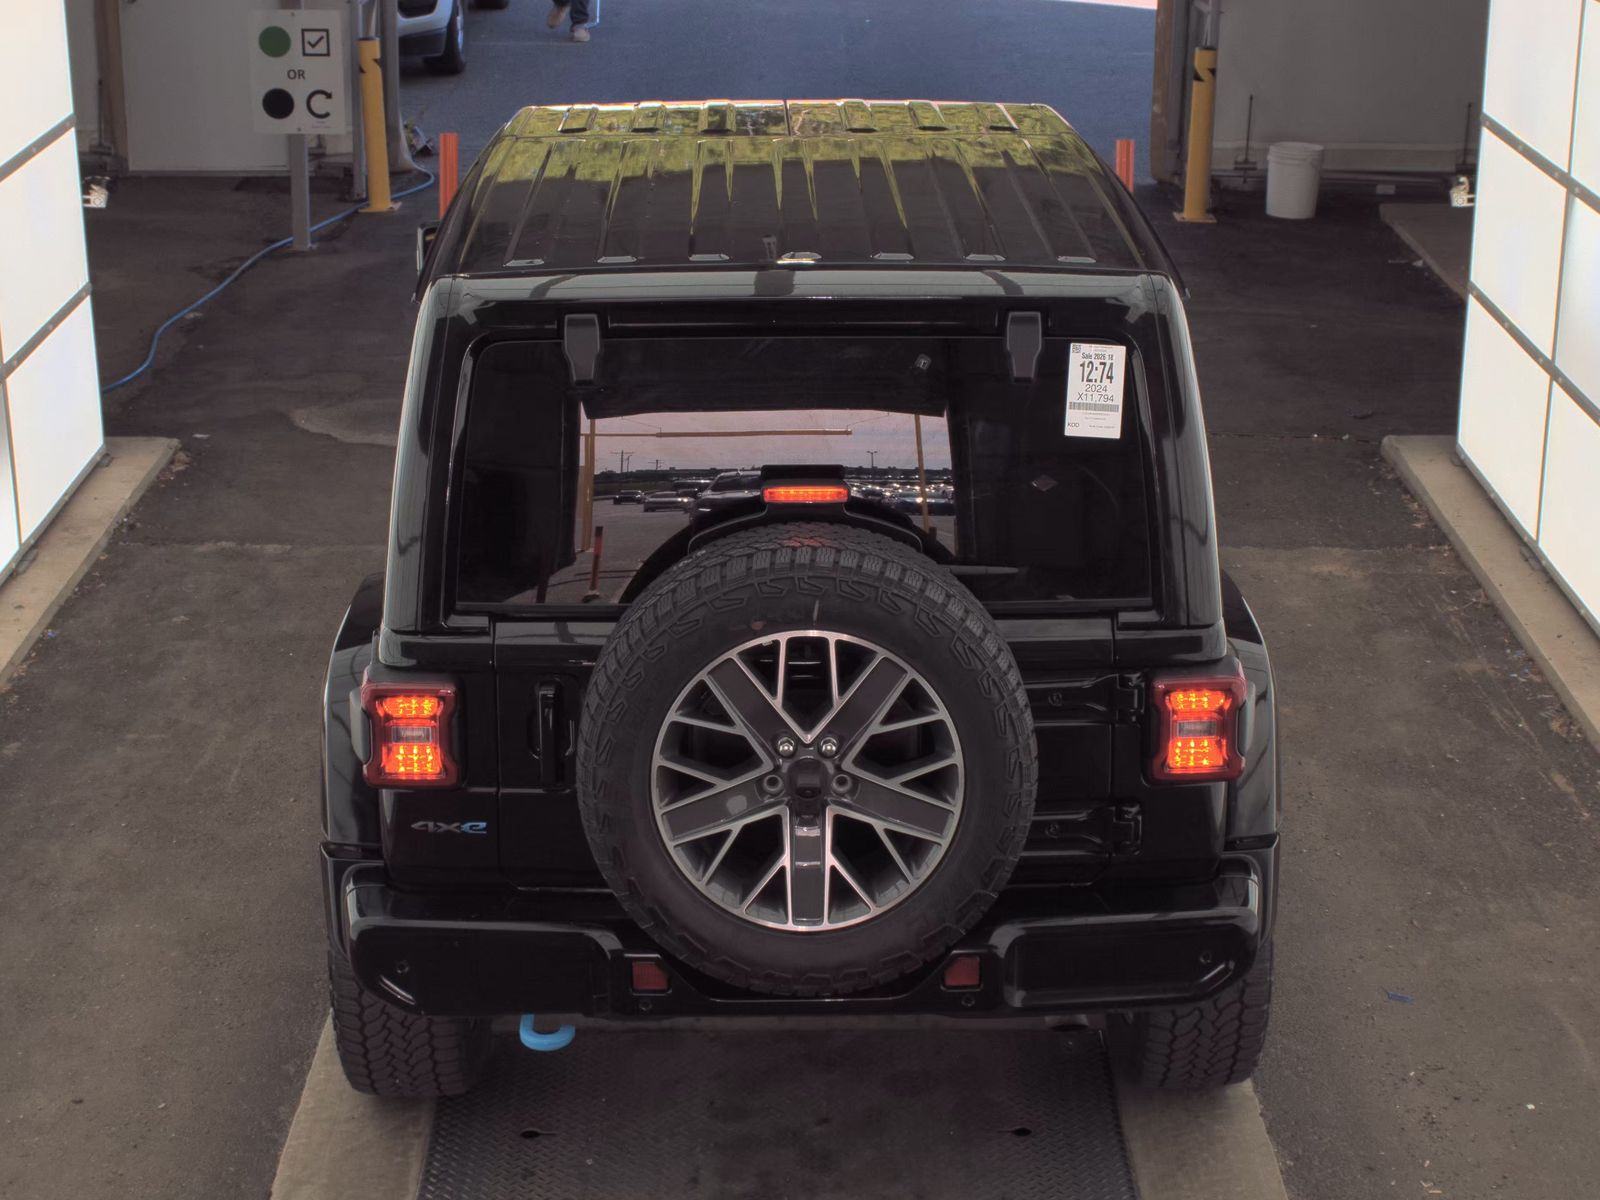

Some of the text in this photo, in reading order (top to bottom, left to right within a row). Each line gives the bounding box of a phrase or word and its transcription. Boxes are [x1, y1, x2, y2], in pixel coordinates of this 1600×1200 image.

[286, 69, 306, 80] OR
[1080, 360, 1114, 384] 12:74
[1085, 383, 1108, 393] 2024
